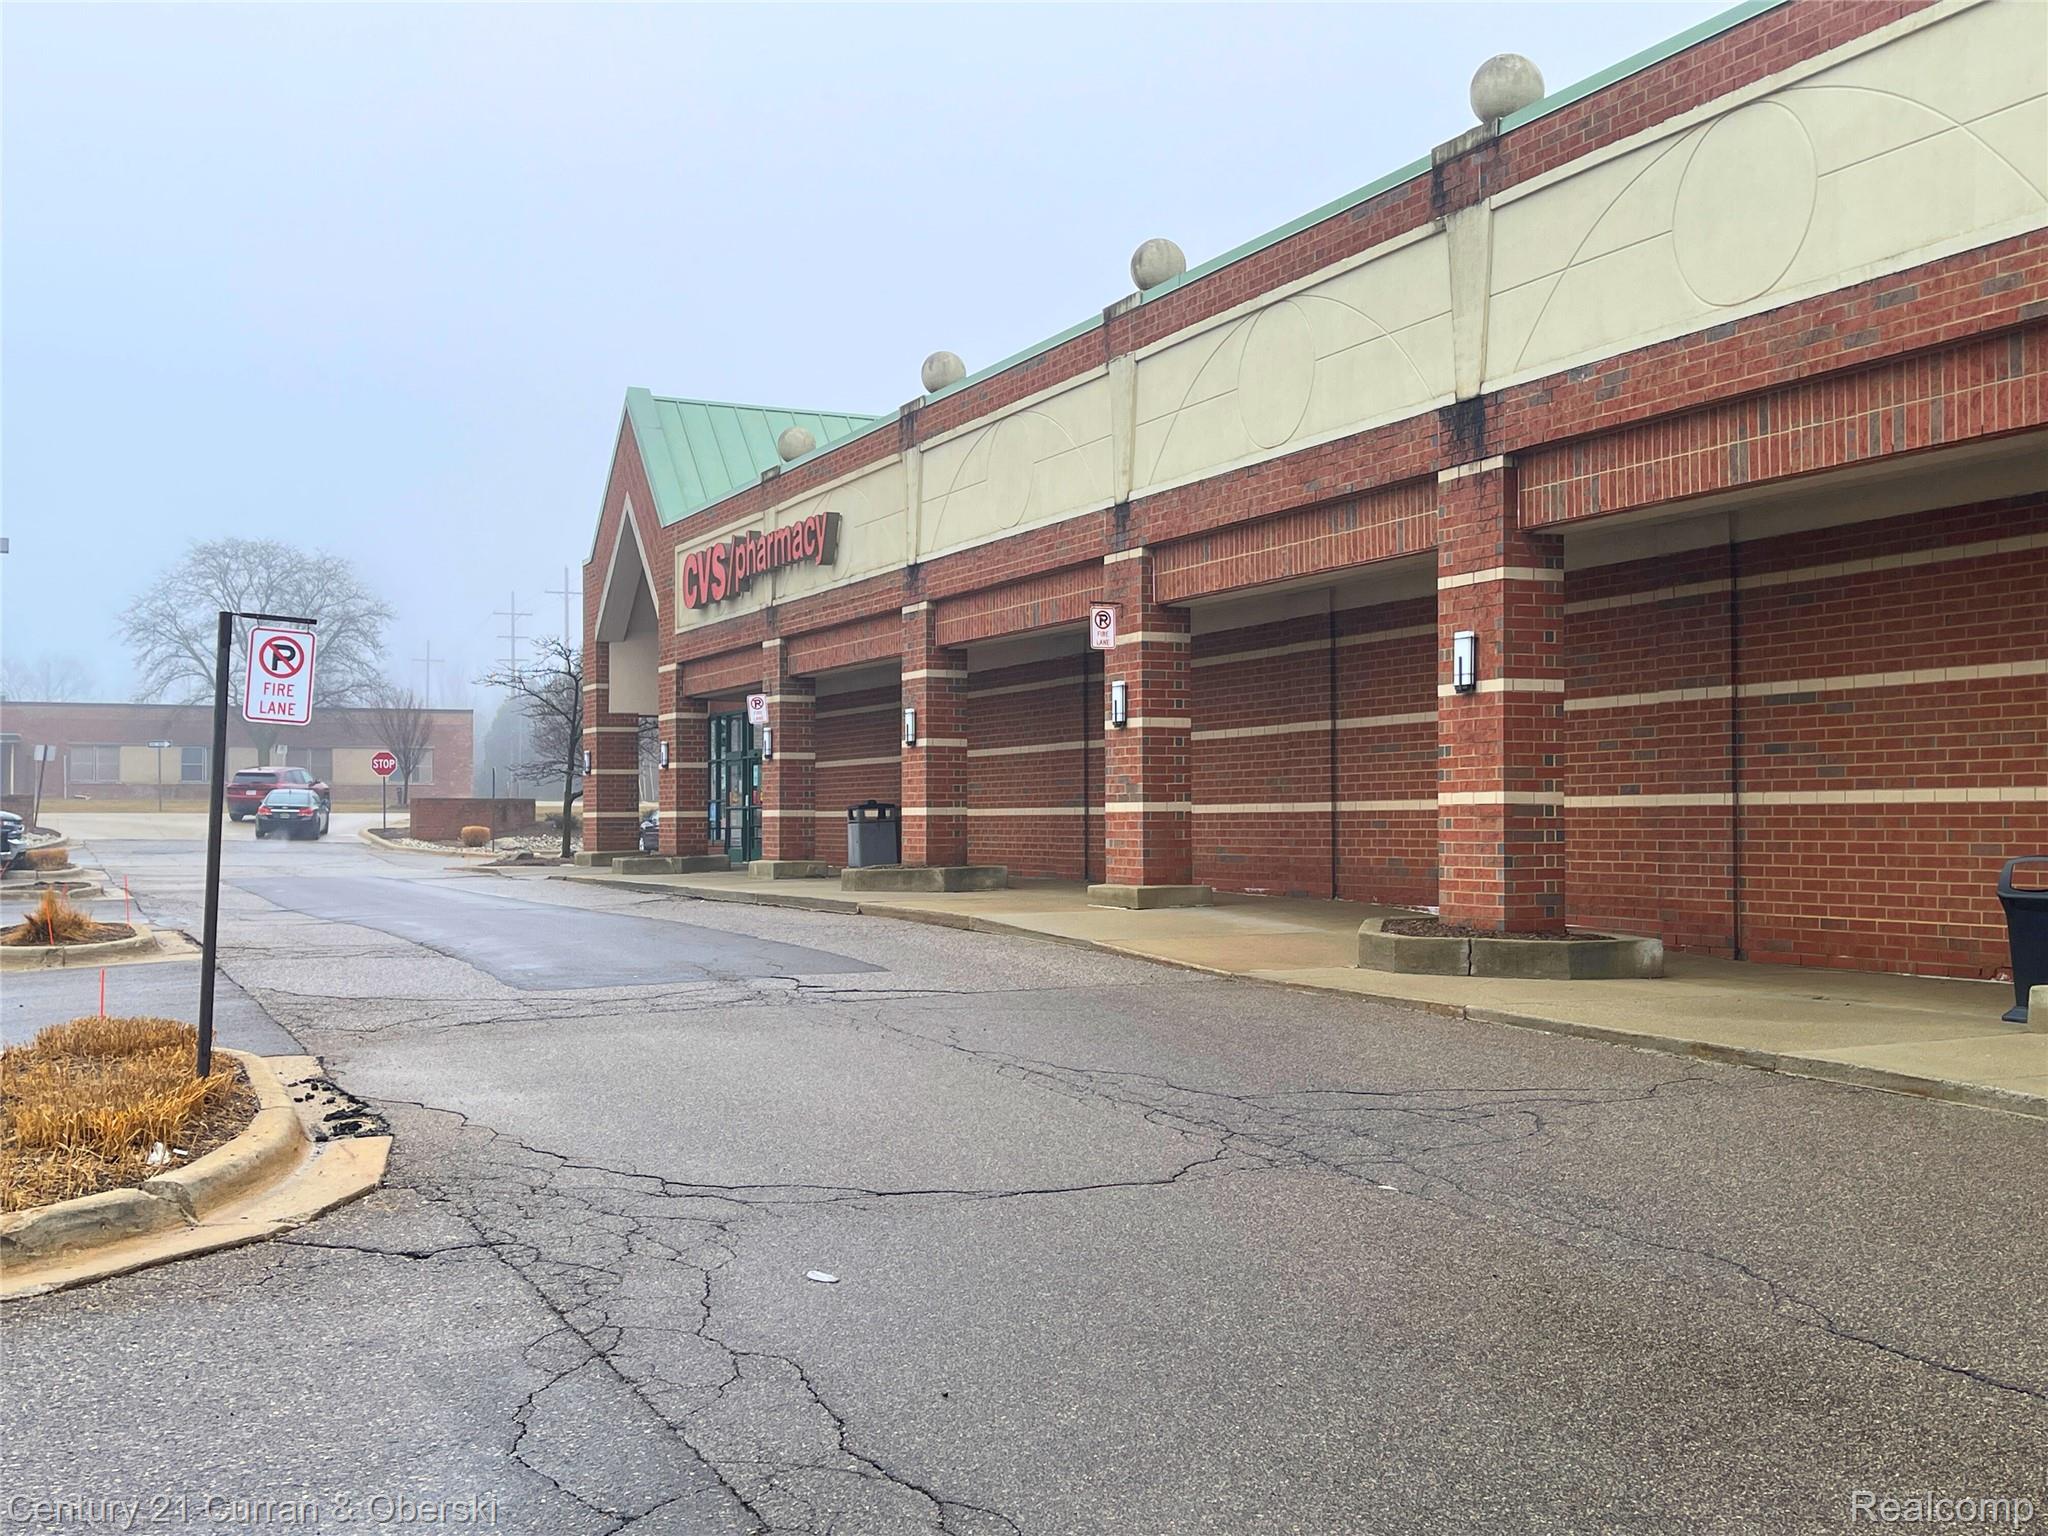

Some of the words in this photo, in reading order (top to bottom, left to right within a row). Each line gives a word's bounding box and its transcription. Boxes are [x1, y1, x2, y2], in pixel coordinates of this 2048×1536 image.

[263, 682, 295, 697] FIRE
[259, 700, 296, 716] LANE
[373, 759, 395, 769] STOP
